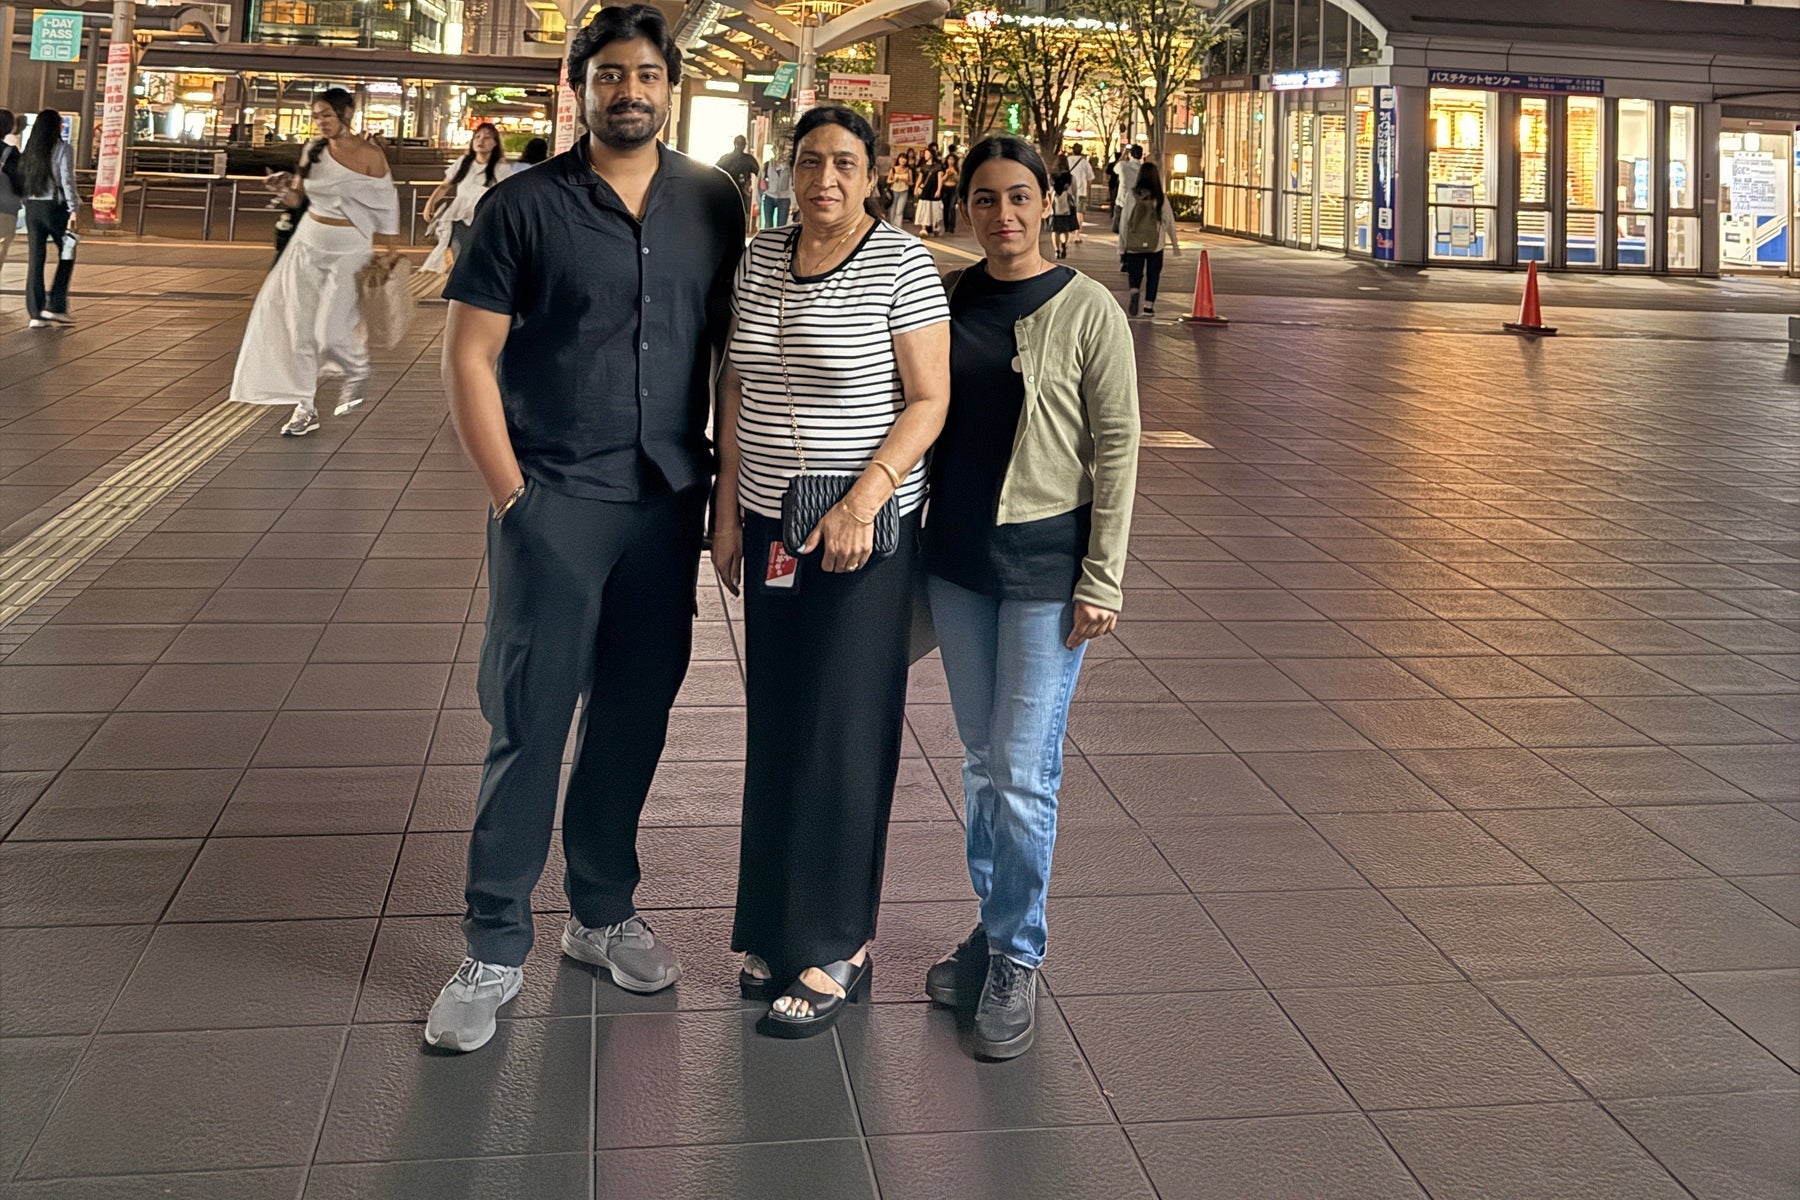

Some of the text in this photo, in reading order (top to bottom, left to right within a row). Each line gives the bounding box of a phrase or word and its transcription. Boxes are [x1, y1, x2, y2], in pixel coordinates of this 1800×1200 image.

[42, 17, 75, 28] 1-DAY
[41, 28, 73, 39] PASS
[1431, 71, 1520, 85] バスチケットセンター
